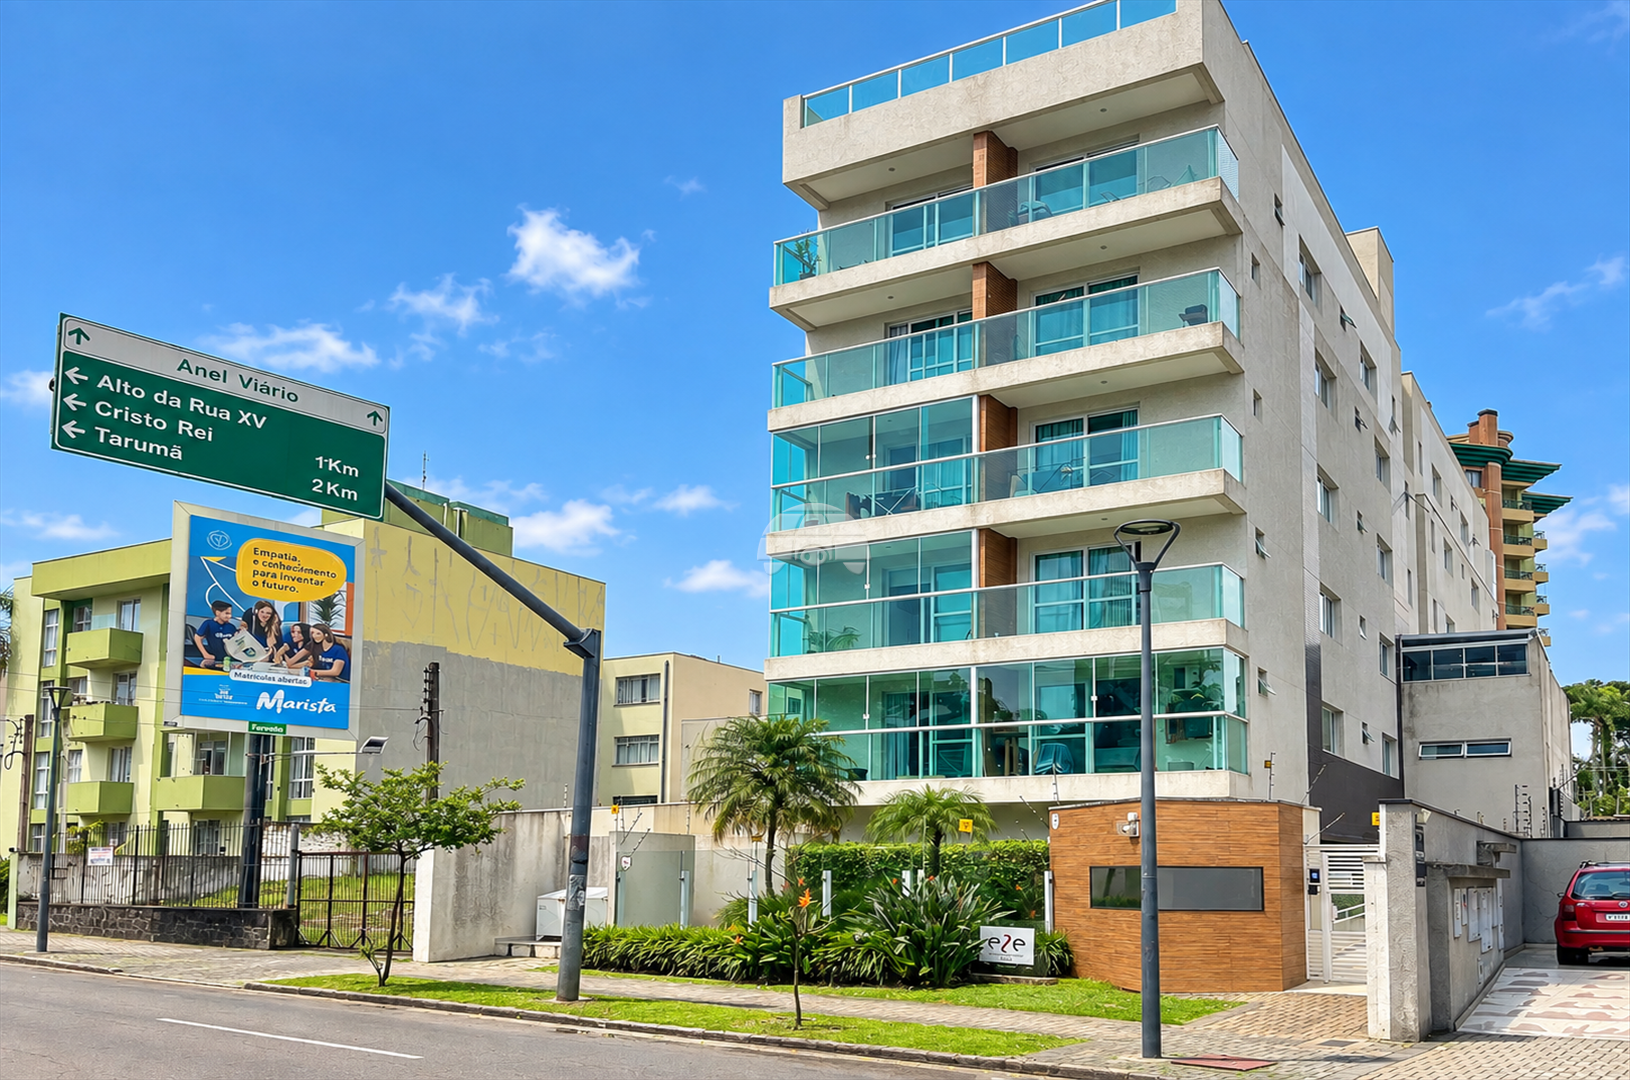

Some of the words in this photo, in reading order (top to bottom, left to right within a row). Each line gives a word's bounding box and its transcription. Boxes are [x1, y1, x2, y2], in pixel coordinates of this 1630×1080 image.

[176, 358, 228, 384] Anel
[238, 373, 299, 402] Viário
[96, 374, 146, 399] Alto
[153, 390, 181, 409] da
[188, 397, 231, 421] Rua
[237, 410, 267, 430] XV
[94, 401, 167, 431] Cristo
[177, 420, 213, 442] Rei
[94, 427, 183, 461] Tarumã
[252, 569, 277, 579] para
[280, 572, 325, 587] inventar
[262, 580, 300, 594] futuro.
[256, 689, 336, 714] Marista
